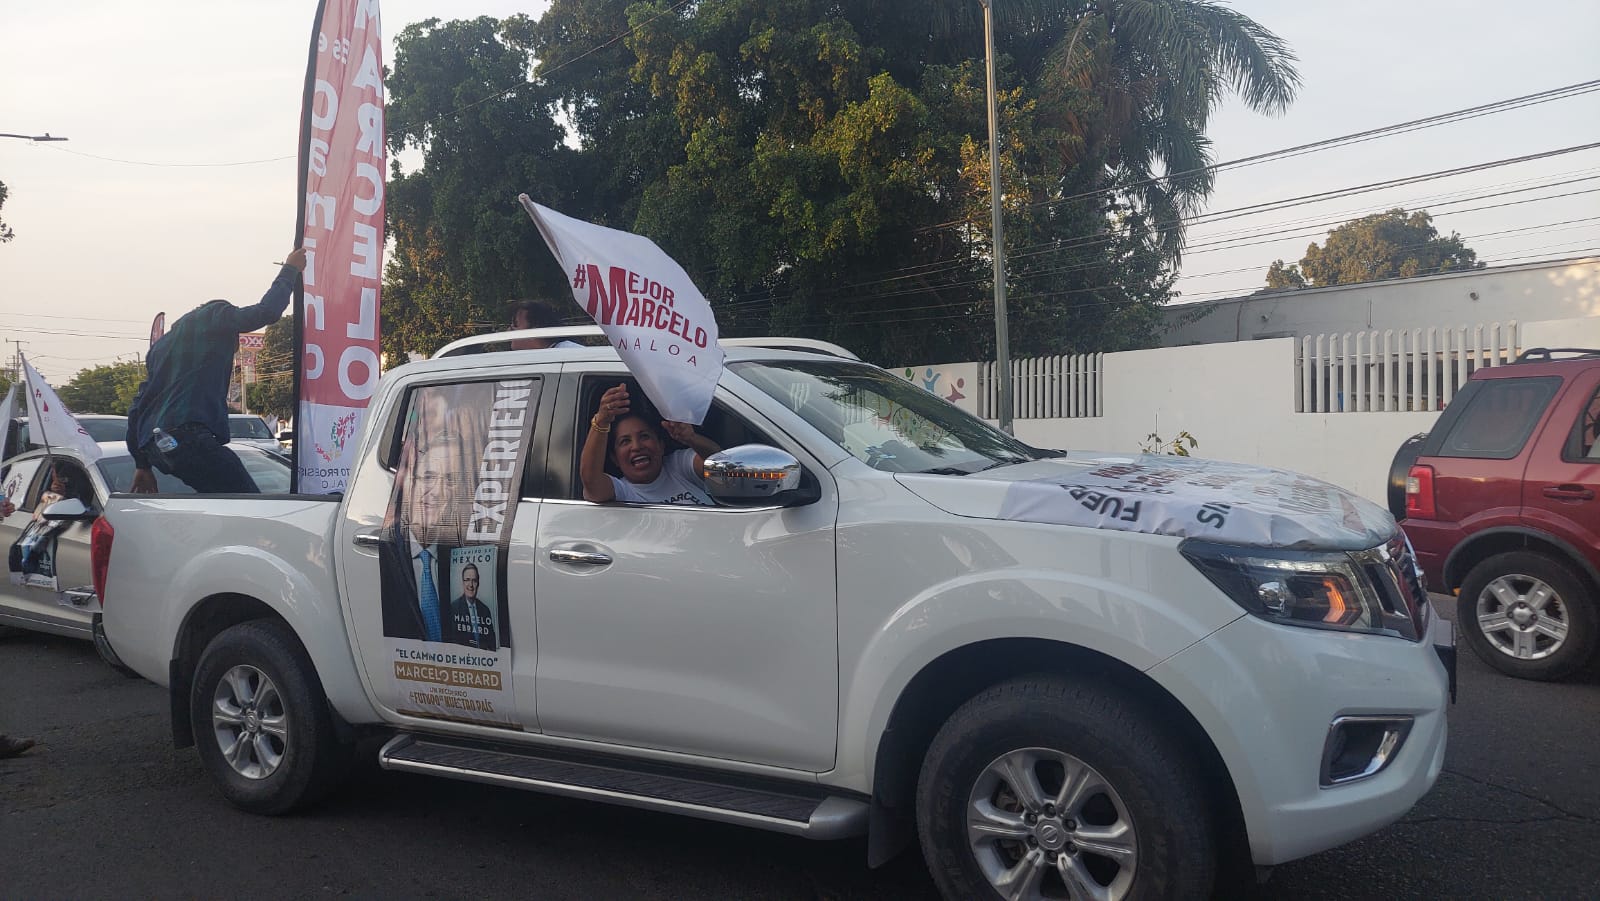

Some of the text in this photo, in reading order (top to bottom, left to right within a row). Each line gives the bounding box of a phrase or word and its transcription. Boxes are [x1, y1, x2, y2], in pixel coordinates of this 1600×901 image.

[618, 338, 697, 366] NALOA
[454, 614, 492, 627] MARCELO
[457, 623, 489, 636] EBRARD
[445, 655, 457, 665] DE
[396, 664, 499, 688] MARCELO EBRARD
